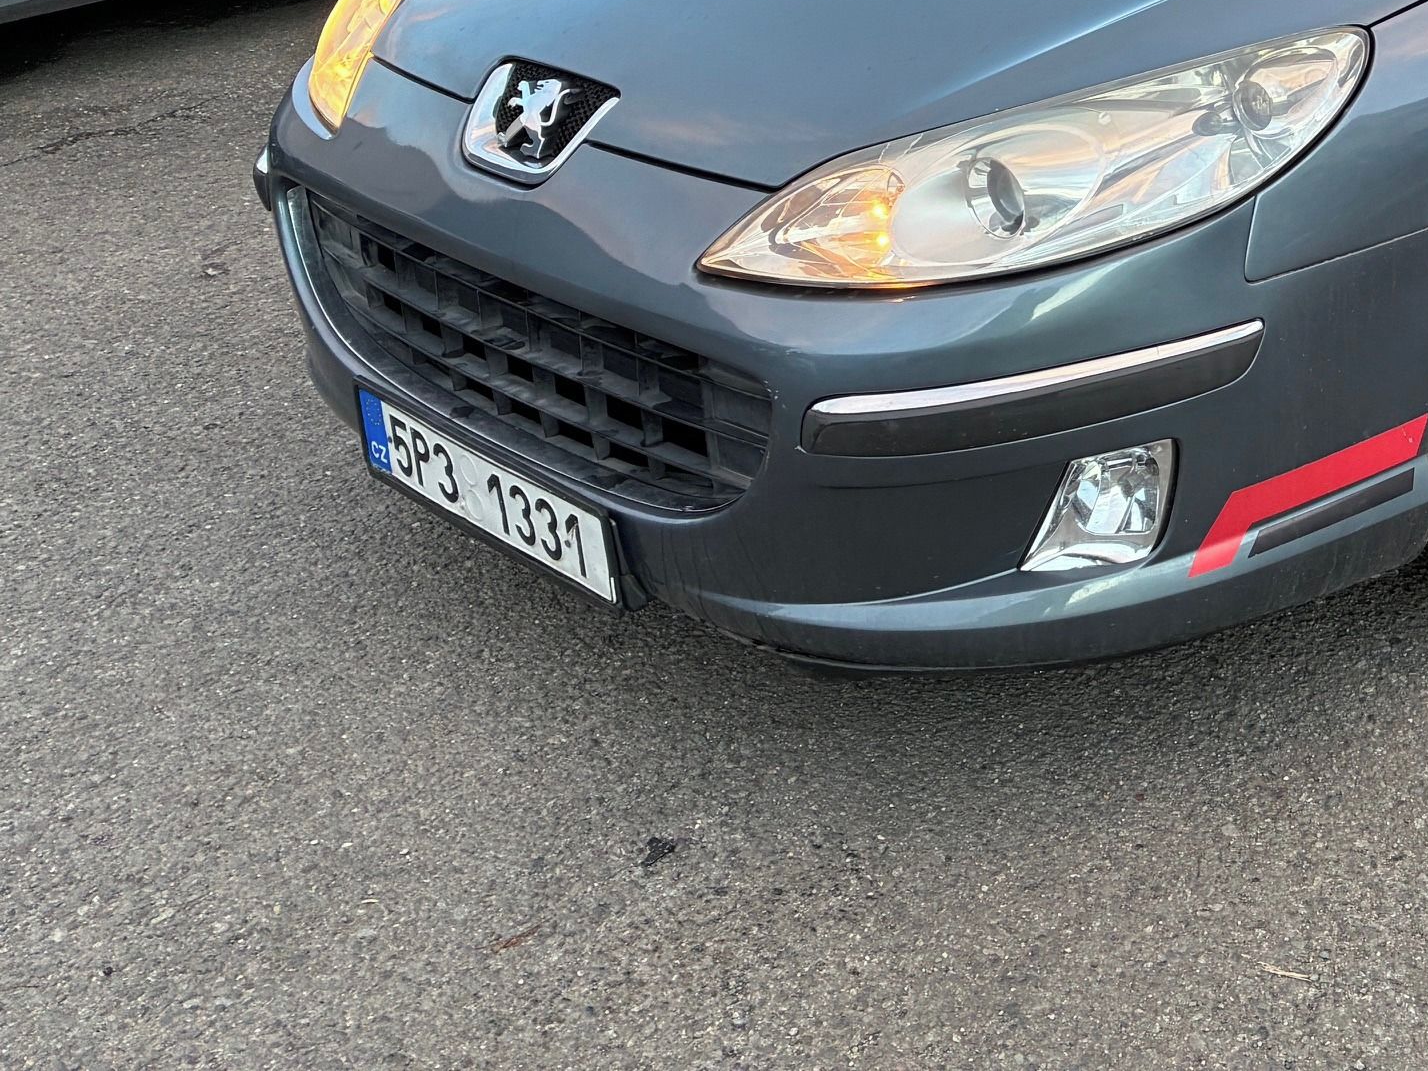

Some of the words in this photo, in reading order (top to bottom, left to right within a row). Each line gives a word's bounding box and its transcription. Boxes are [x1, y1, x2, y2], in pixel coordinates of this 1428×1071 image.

[371, 440, 388, 464] CZ
[389, 413, 459, 504] 5P3
[487, 473, 588, 579] 1331
